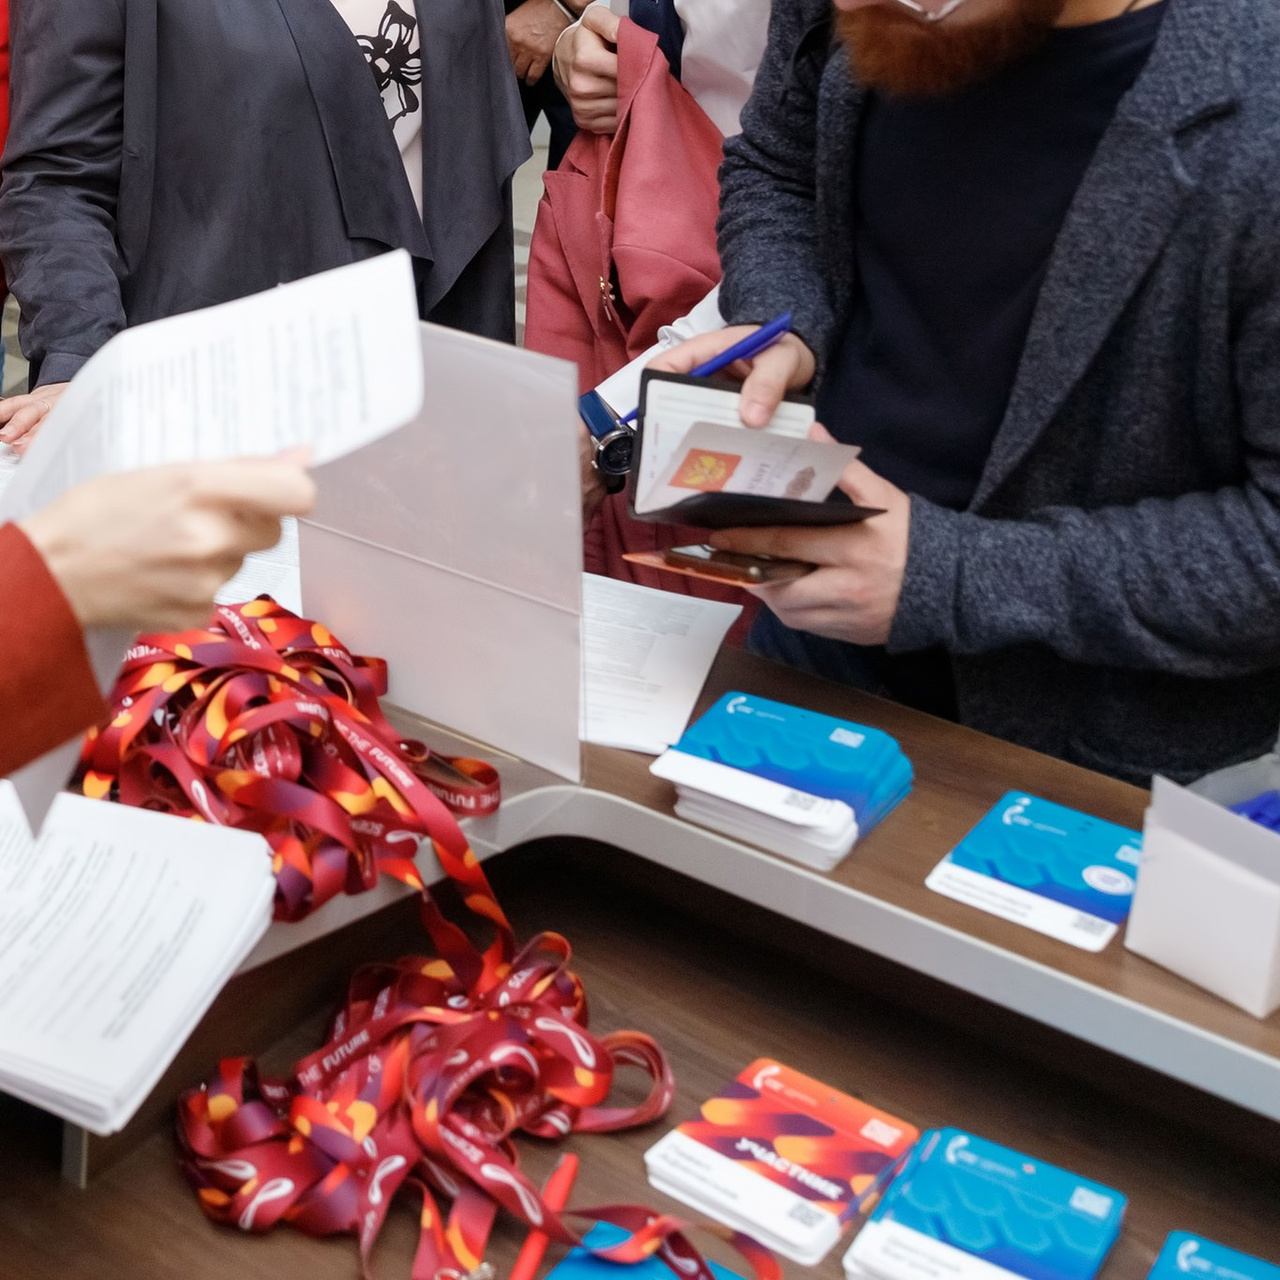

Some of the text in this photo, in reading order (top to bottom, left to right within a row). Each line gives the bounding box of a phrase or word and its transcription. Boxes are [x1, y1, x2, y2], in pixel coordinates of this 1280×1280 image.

[347, 730, 372, 752] THE
[369, 747, 415, 788] FUTURE
[322, 1028, 370, 1071] FUTURE
[735, 1136, 845, 1201] УЧАСТНИК
